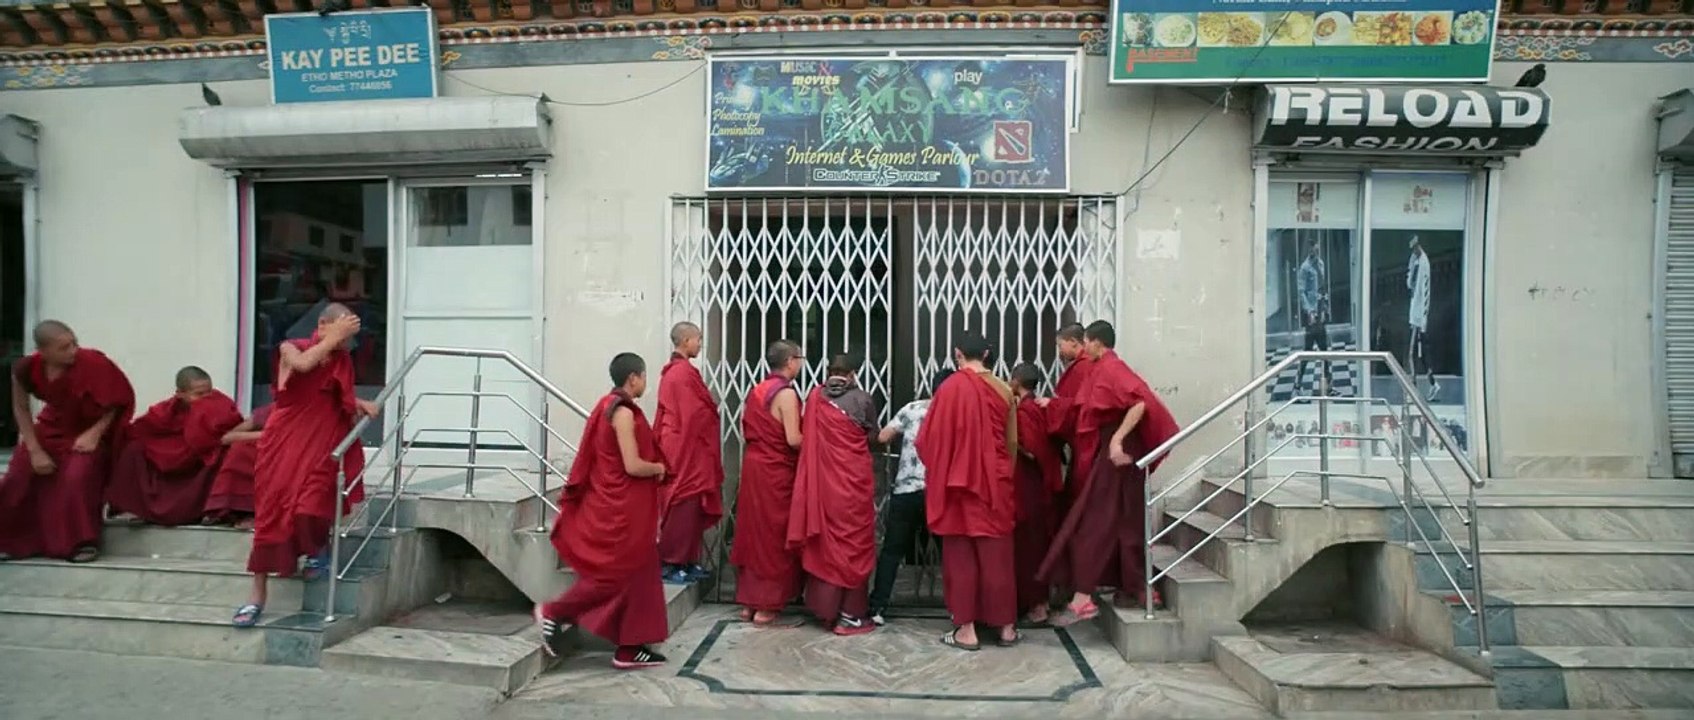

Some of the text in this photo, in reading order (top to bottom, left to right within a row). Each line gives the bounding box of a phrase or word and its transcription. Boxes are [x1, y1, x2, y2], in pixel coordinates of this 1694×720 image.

[281, 43, 420, 70] KAY PEE DEE
[366, 68, 398, 78] PLAZA
[792, 75, 840, 86] movies
[954, 69, 983, 84] play
[1271, 86, 1544, 128] RELOAD
[831, 119, 935, 144] ALAXY
[786, 145, 980, 167] Internet & Games Parlour
[973, 169, 1031, 185] DOTA
